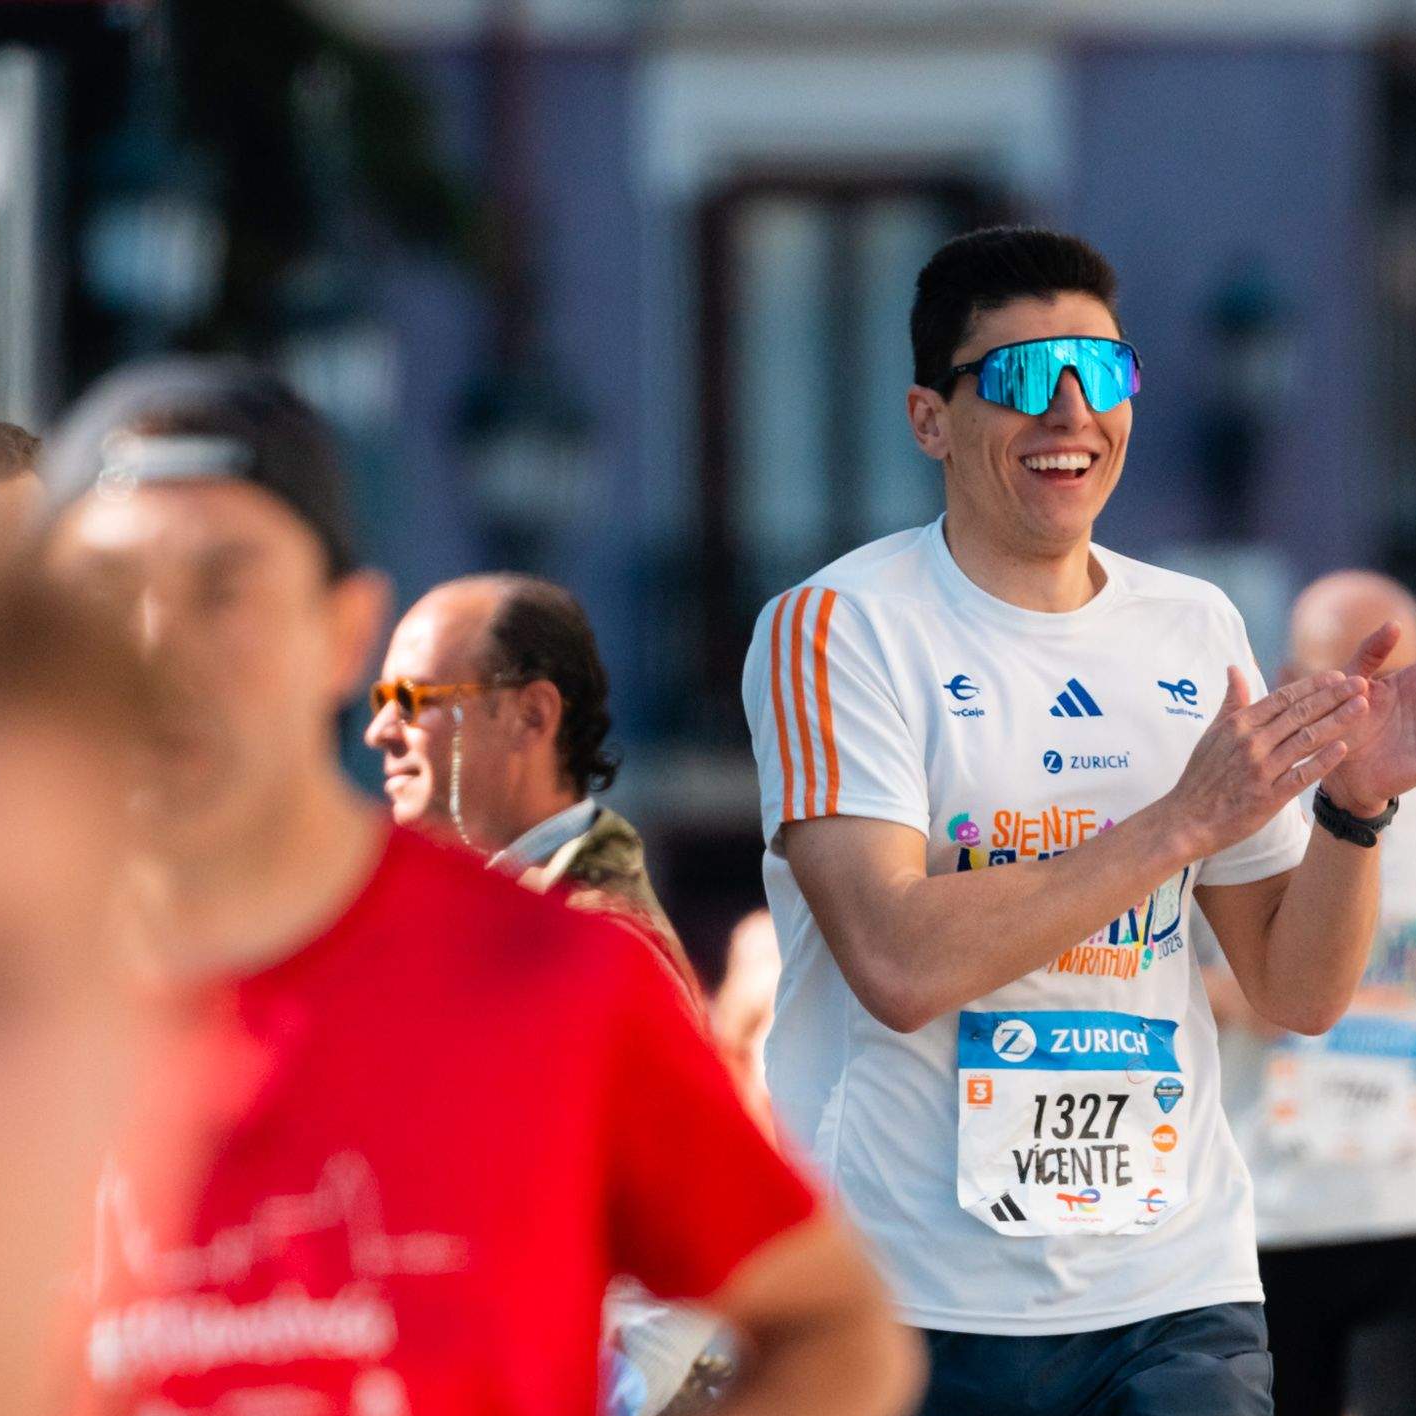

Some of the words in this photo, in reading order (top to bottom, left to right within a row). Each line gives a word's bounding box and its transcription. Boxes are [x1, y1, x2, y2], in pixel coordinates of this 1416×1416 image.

[1070, 752, 1129, 770] ZURICH
[991, 805, 1096, 857] SIENTE
[1050, 1028, 1150, 1056] ZURICH
[1033, 1092, 1131, 1140] 1327
